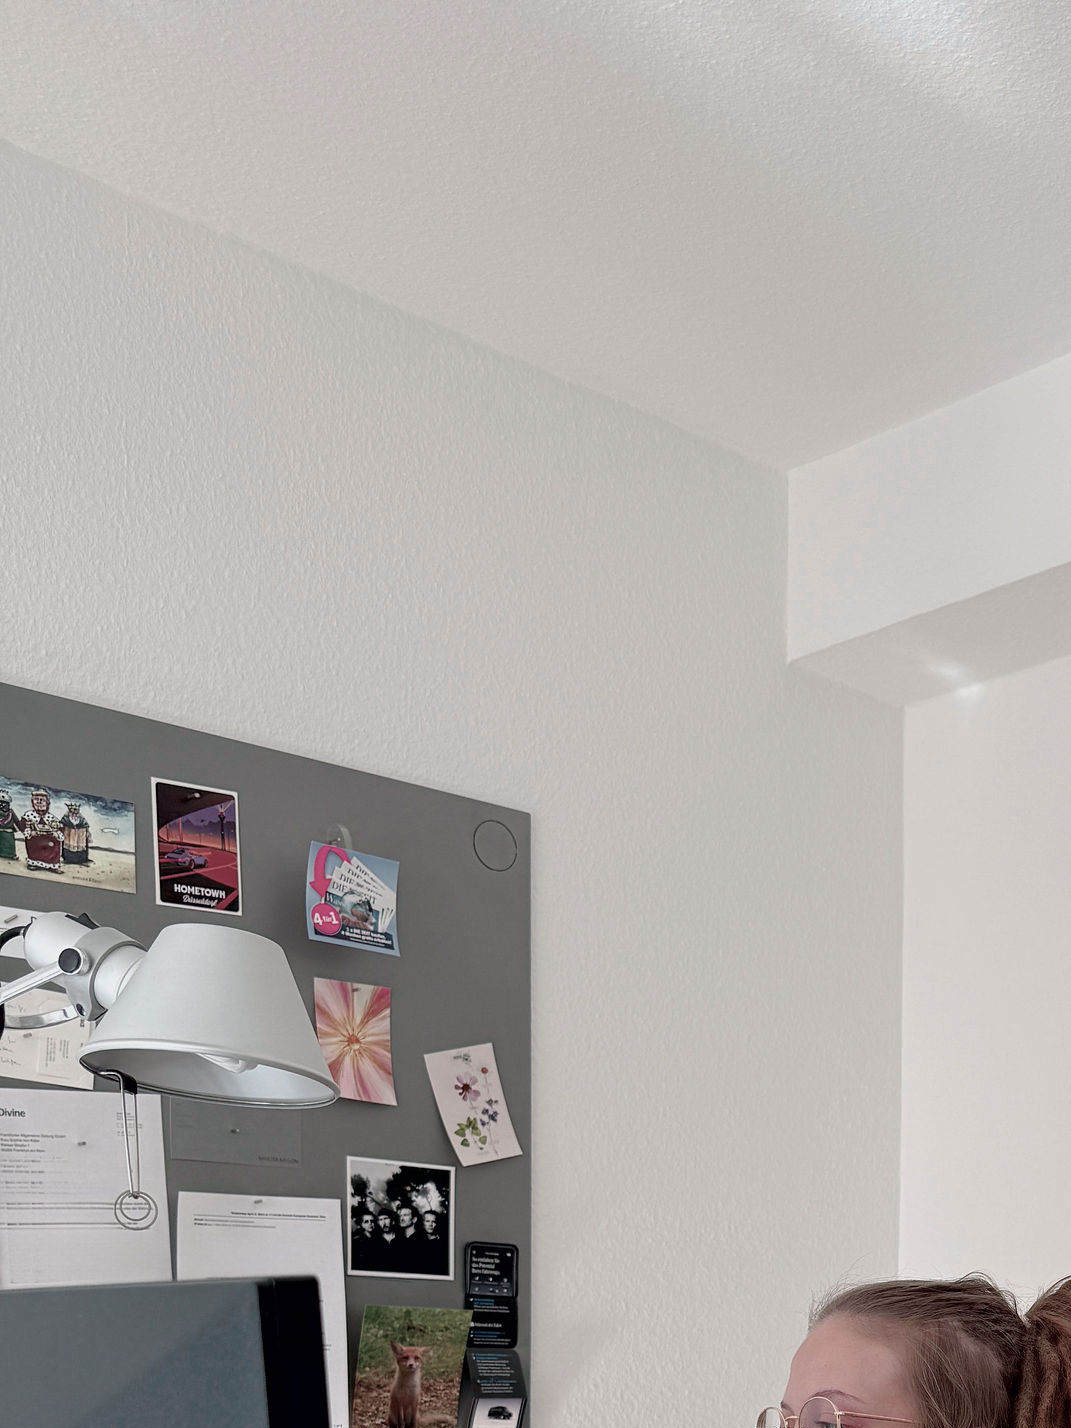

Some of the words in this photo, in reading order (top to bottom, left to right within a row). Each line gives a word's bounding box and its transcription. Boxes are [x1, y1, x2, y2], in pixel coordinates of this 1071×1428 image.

[173, 883, 226, 899] HOMETOWN
[332, 881, 348, 893] DIE
[314, 913, 323, 925] 4
[330, 912, 339, 924] 1
[0, 1108, 26, 1118] Divine
